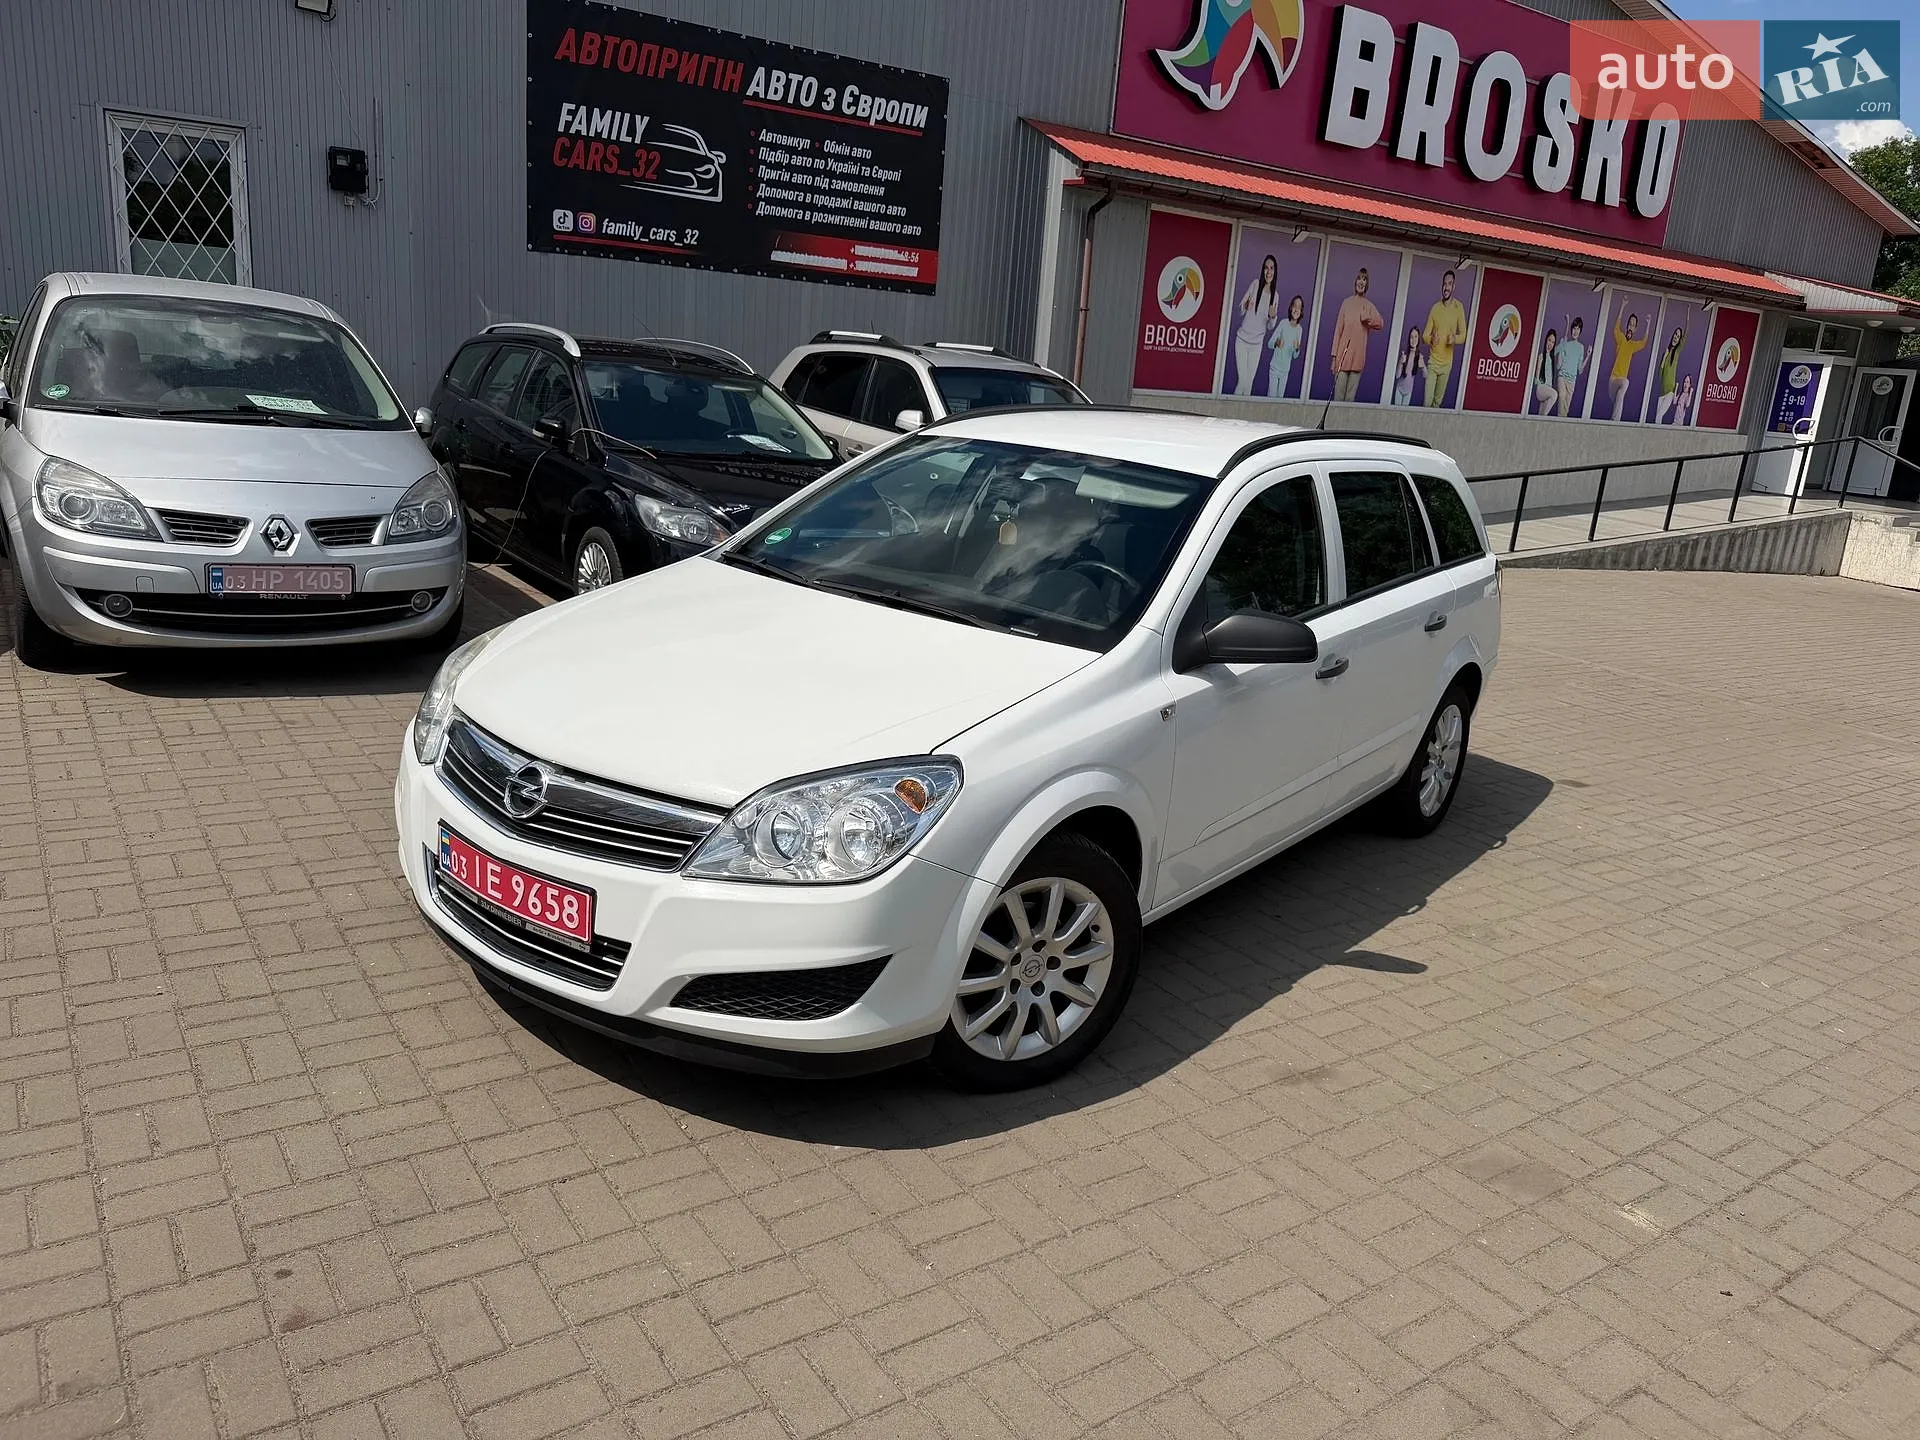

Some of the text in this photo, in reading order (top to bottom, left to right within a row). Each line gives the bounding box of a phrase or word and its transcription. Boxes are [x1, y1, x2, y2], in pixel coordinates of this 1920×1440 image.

[554, 27, 929, 129] АВТОПРИГІН АВТО з Європи
[557, 102, 650, 144] FAMILY
[1325, 4, 1680, 219] BROSKO
[552, 136, 661, 180] CARS_32
[758, 128, 873, 160] Автовикуп Обмін авто
[758, 146, 902, 182] Підбір авто по Україні та Європі
[757, 165, 886, 197] Пригін авто під замовлення
[756, 182, 907, 217] Допомога в продажі вашого авто
[602, 217, 700, 247] family_cars_32
[755, 200, 922, 236] Допомога в розмитненні вашого авто
[1144, 324, 1207, 350] BROSKO
[1477, 358, 1521, 379] BROSKO
[1706, 383, 1738, 401] BROSKO
[1788, 395, 1806, 406] 9-19
[212, 582, 224, 590] UA
[225, 569, 345, 590] 03 HP 1405
[442, 852, 451, 867] UA
[451, 850, 468, 880] 03
[475, 855, 503, 900] IE
[511, 874, 580, 930] 9658
